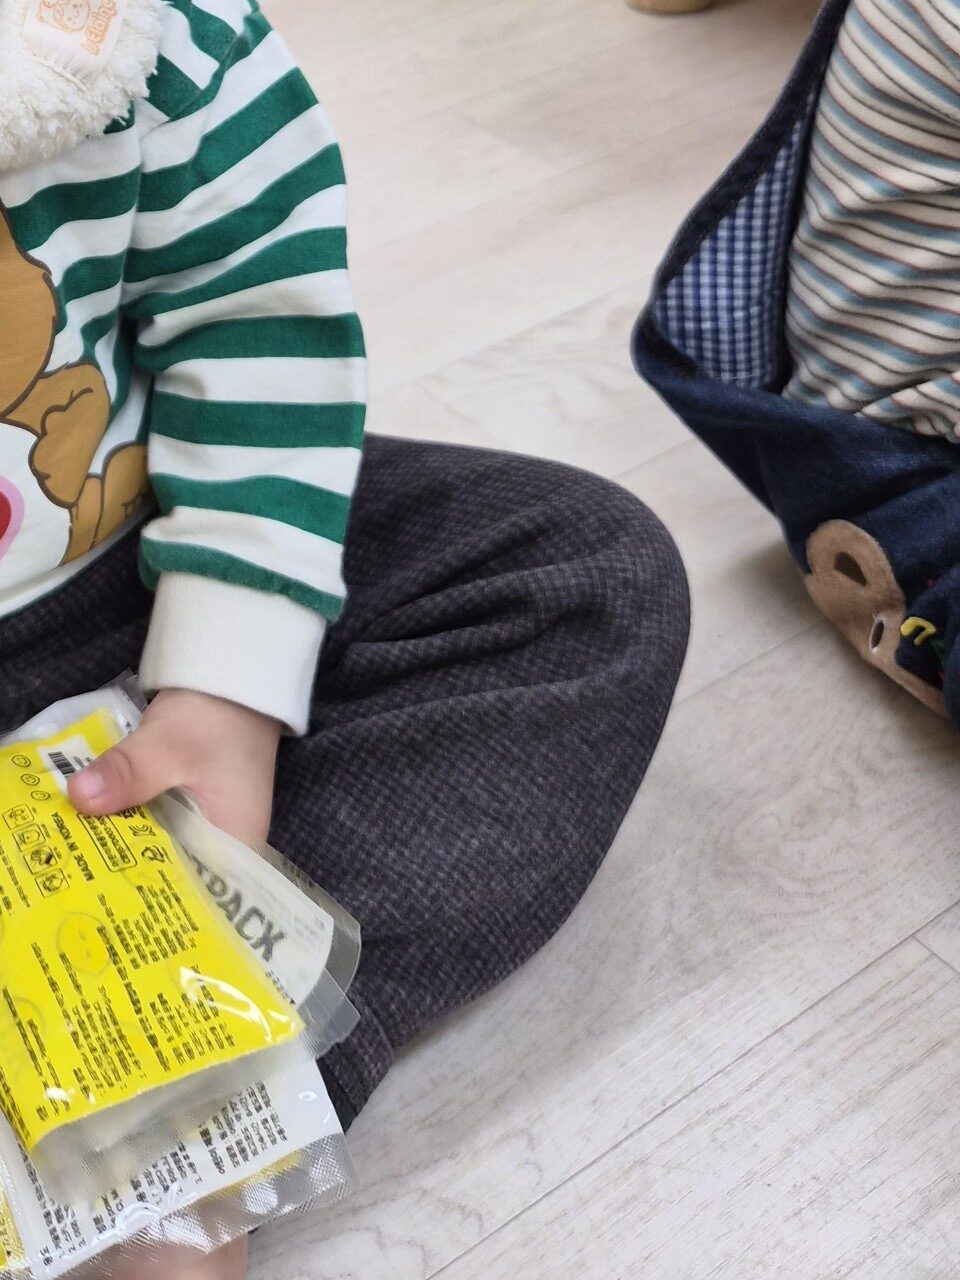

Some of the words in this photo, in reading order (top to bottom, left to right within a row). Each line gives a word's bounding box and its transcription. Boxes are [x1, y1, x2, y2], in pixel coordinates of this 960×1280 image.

[51, 811, 72, 840] KOREA
[66, 841, 79, 852] IN
[74, 853, 95, 881] MADE
[187, 850, 284, 961] TPACK
